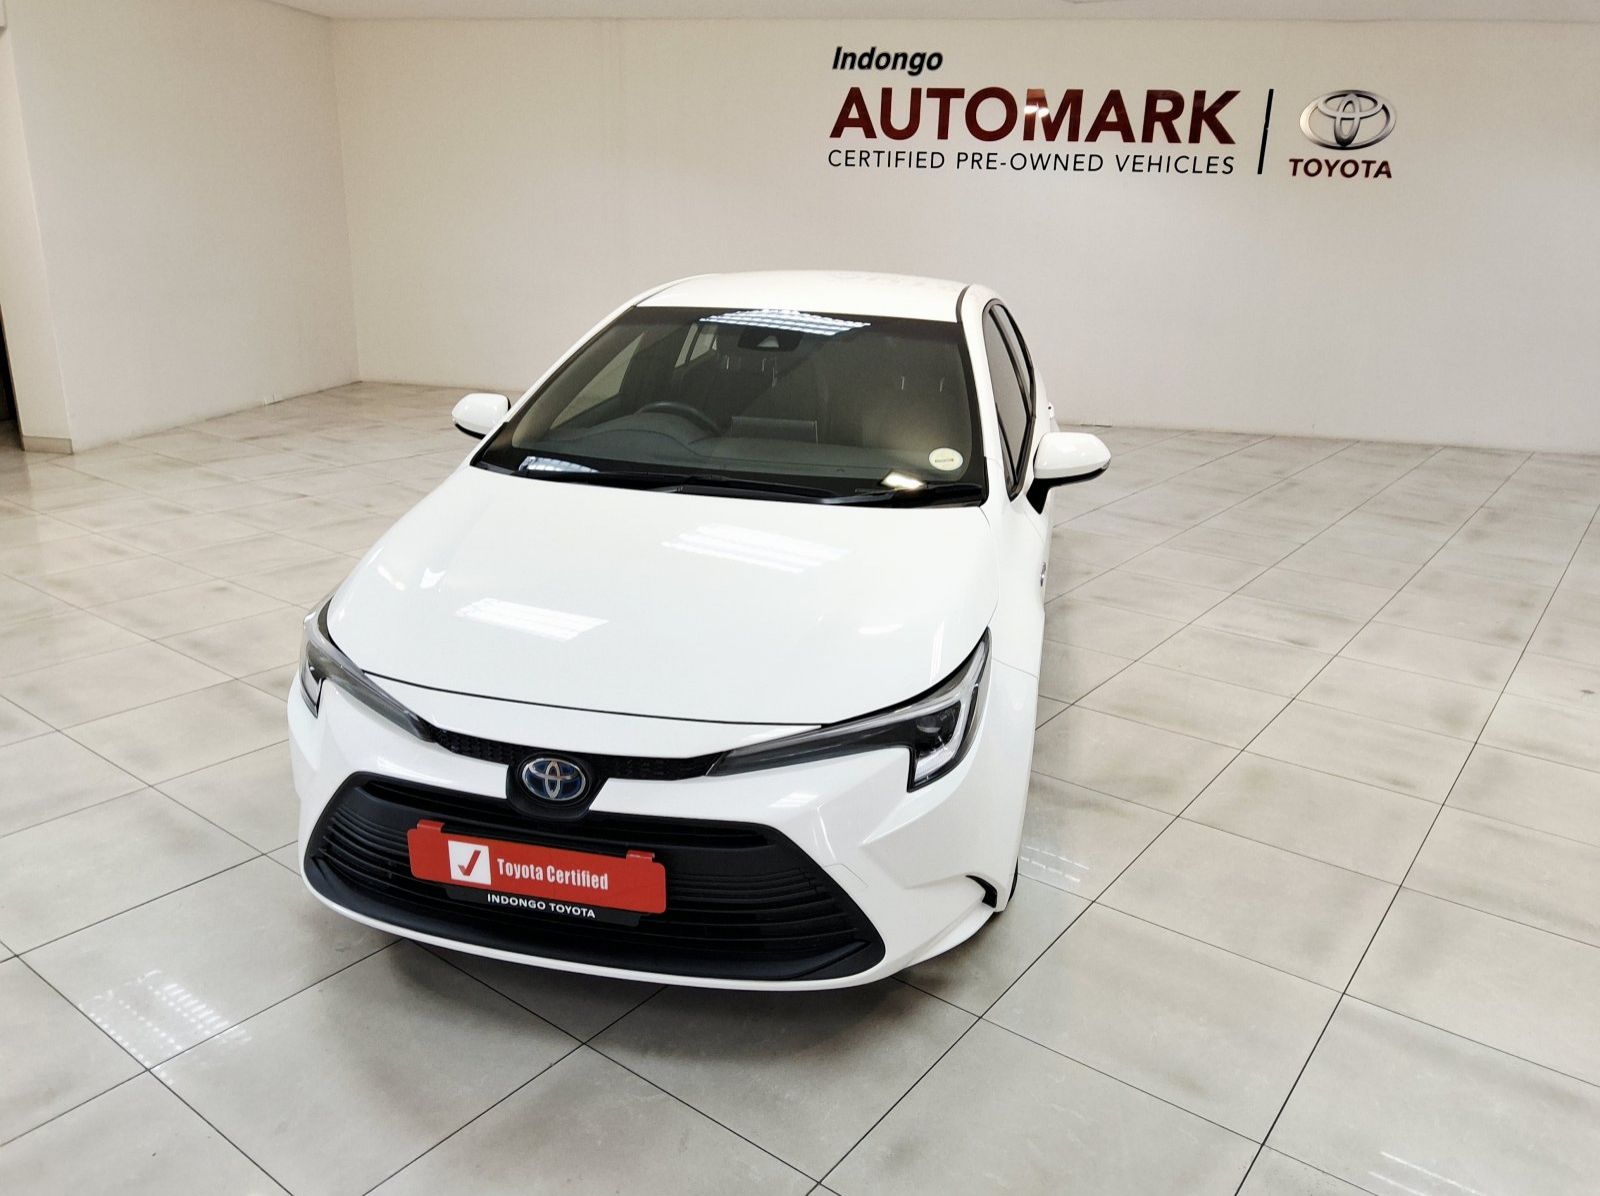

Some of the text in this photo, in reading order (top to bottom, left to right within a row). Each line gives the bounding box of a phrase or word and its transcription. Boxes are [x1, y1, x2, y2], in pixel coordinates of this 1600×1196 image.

[832, 46, 943, 76] Indongo
[829, 87, 1241, 145] AUTOMARK
[828, 150, 1235, 175] CERTIFIED PRE-OWNED VEHICLES
[1289, 158, 1393, 179] TOYOTA
[497, 858, 608, 890] Toyota Certified
[487, 893, 596, 918] INDONGO TOYOTA
